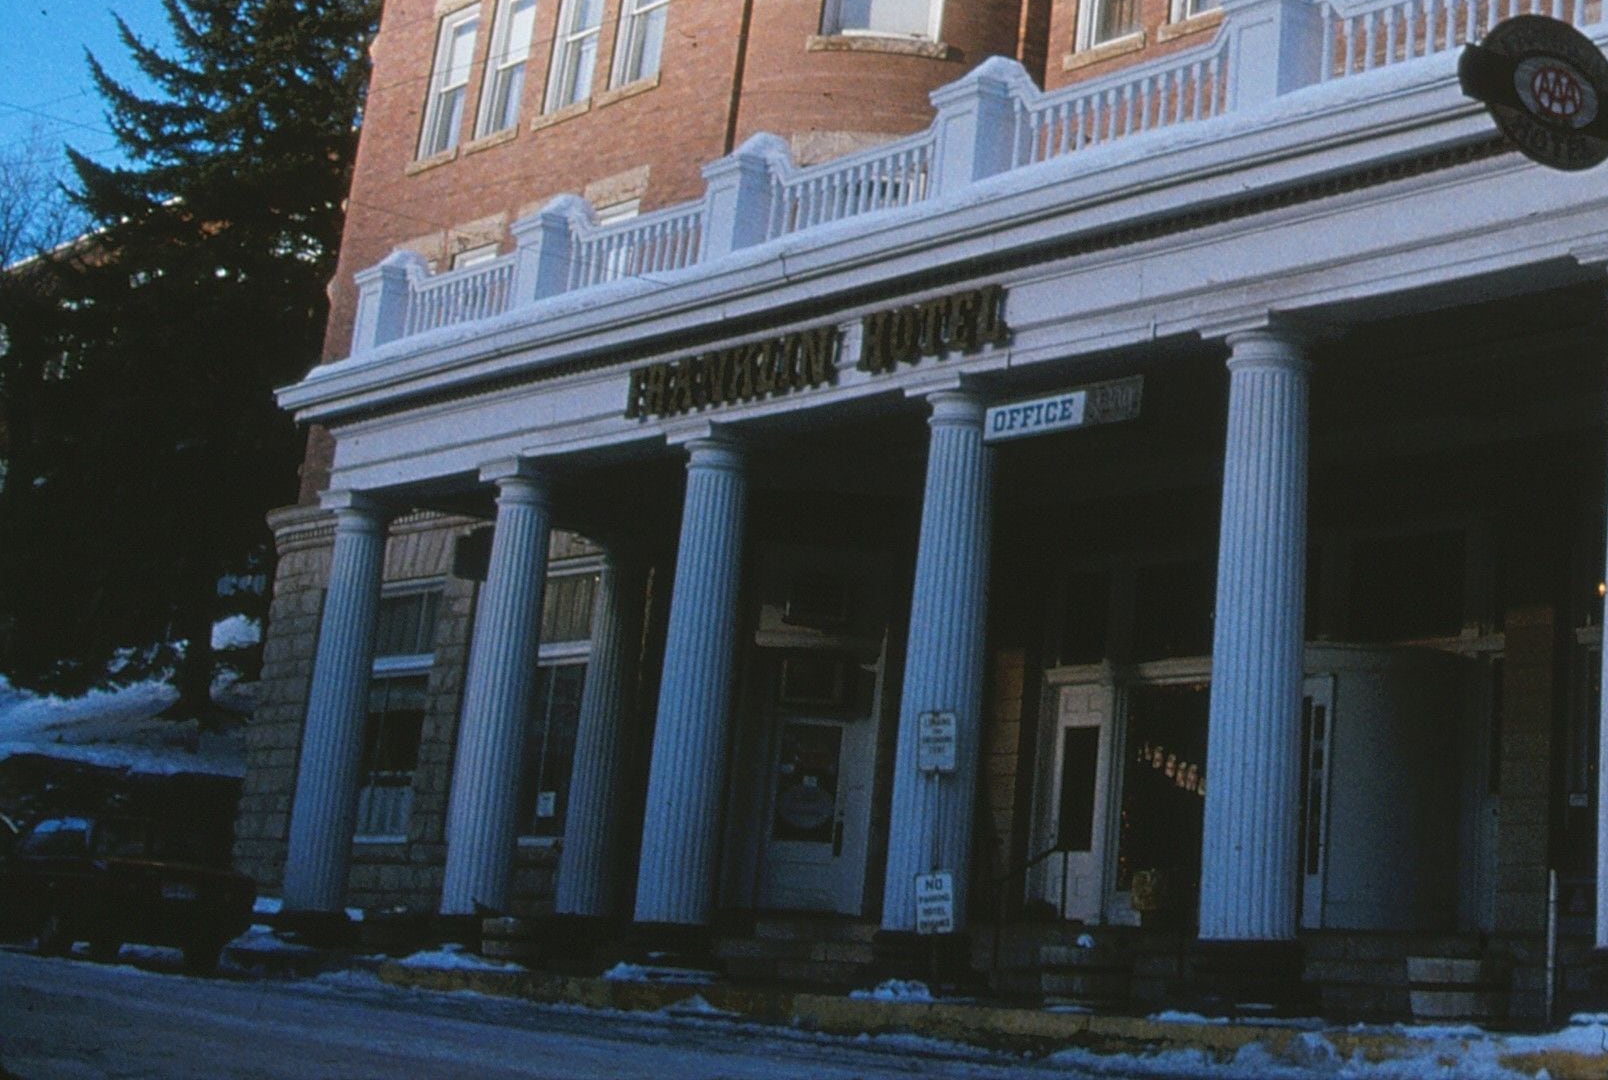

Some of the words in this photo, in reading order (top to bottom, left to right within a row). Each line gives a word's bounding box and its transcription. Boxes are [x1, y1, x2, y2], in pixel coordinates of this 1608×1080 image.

[1533, 69, 1582, 116] AAA
[625, 323, 838, 420] FRANKLIN
[857, 283, 1010, 373] HOTEL
[993, 397, 1075, 433] OFFICE
[924, 877, 943, 891] NO
